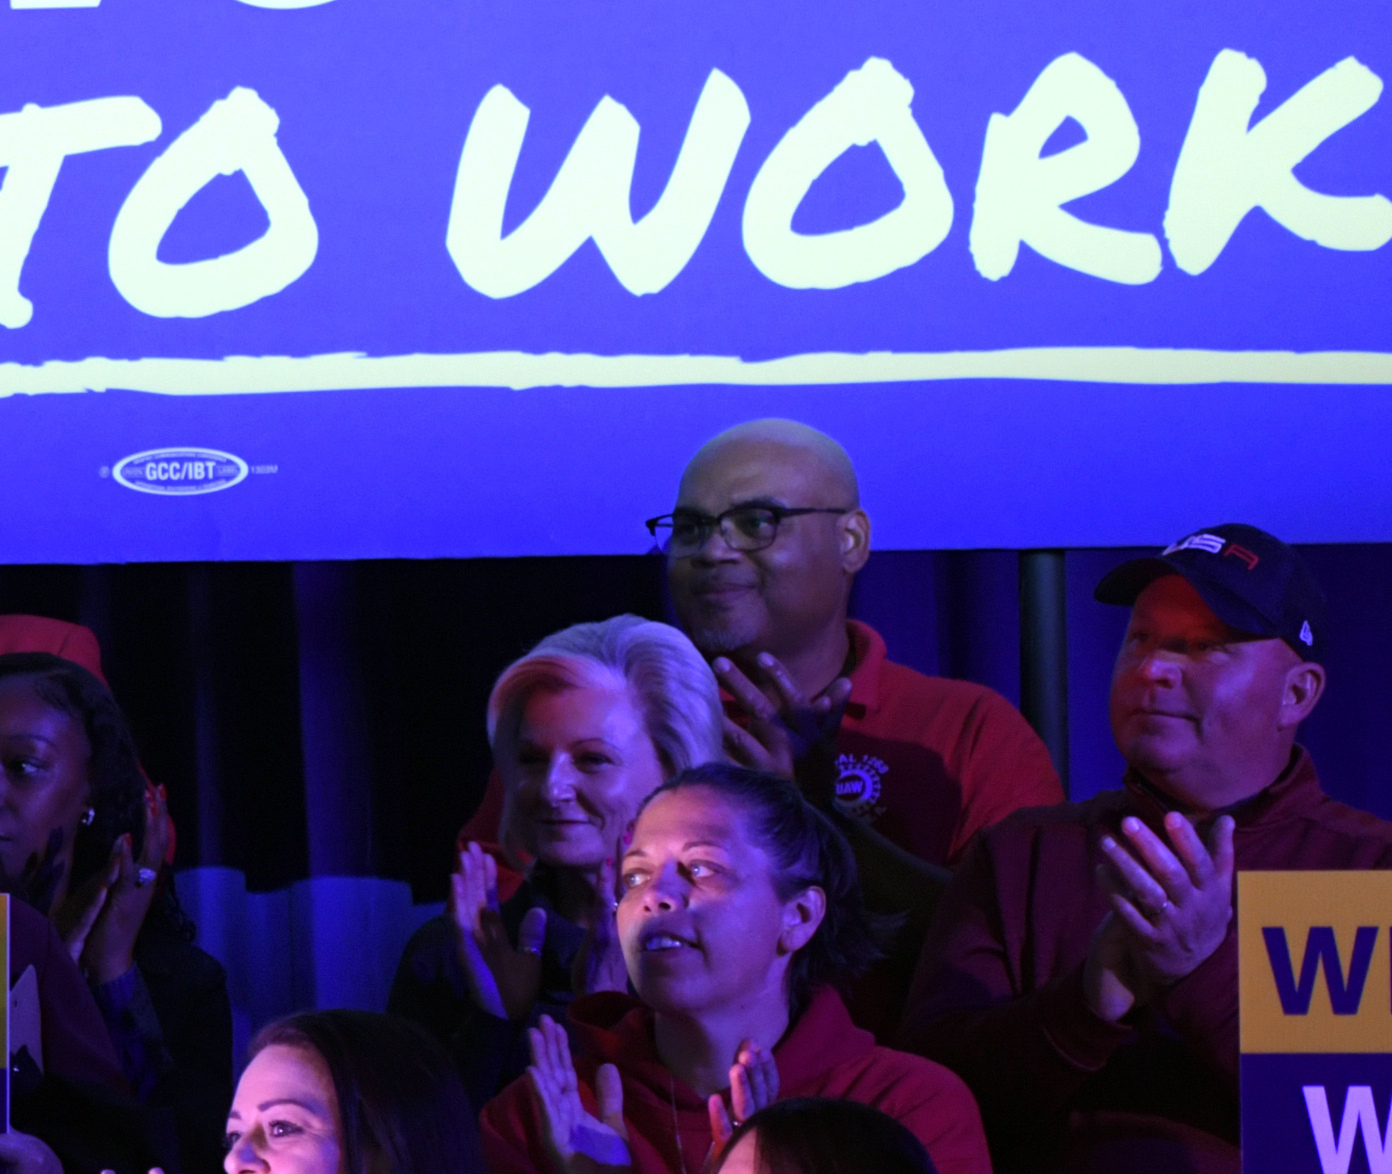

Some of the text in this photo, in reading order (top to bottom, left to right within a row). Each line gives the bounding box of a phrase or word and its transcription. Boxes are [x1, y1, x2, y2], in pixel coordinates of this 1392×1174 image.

[446, 48, 1392, 298] WORK
[145, 461, 217, 481] GCC/IBT
[1262, 926, 1392, 1017] W
